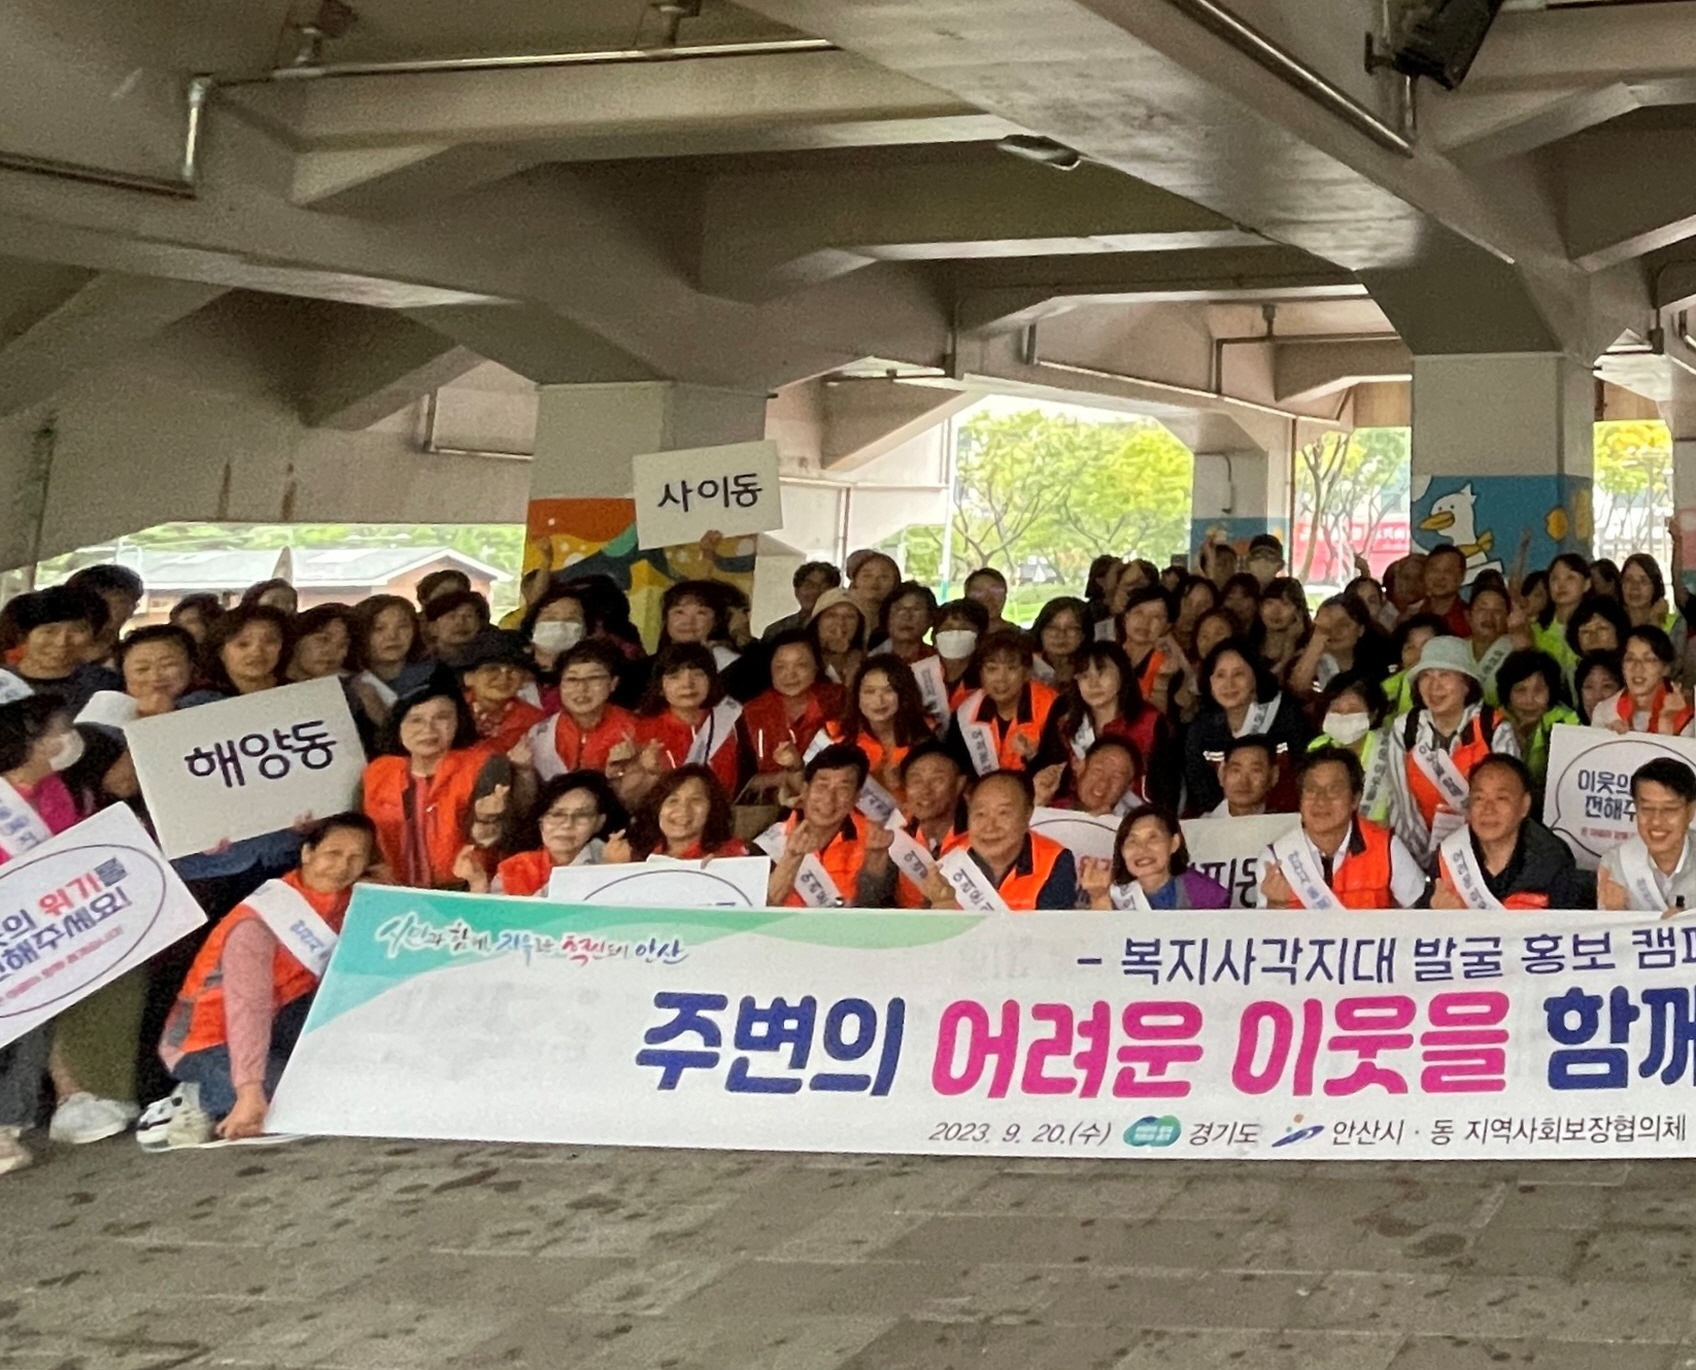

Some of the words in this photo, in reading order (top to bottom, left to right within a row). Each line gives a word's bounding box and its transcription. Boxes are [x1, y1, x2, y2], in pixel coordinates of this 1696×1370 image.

[658, 473, 763, 513] 사이동
[184, 720, 337, 788] 해양동
[1578, 769, 1629, 794] 이웃의
[1586, 796, 1636, 822] 전해주
[39, 857, 128, 917] 위기를
[635, 937, 690, 965] 안산
[1121, 936, 1396, 986] 복지사각지대
[1413, 936, 1504, 983] 발굴
[1520, 932, 1615, 974] 홍보
[635, 991, 906, 1097] 주변의
[931, 998, 1203, 1099] 어려운
[1231, 990, 1511, 1099] 이웃을
[929, 1122, 990, 1143] 2023.
[1002, 1123, 1020, 1143] 9.
[1032, 1121, 1112, 1147] 20.(수)
[1189, 1121, 1260, 1146] 경기도
[1331, 1118, 1405, 1146] 안산시
[1430, 1119, 1455, 1146] 동
[1464, 1113, 1687, 1145] 지역사회보장협의체
